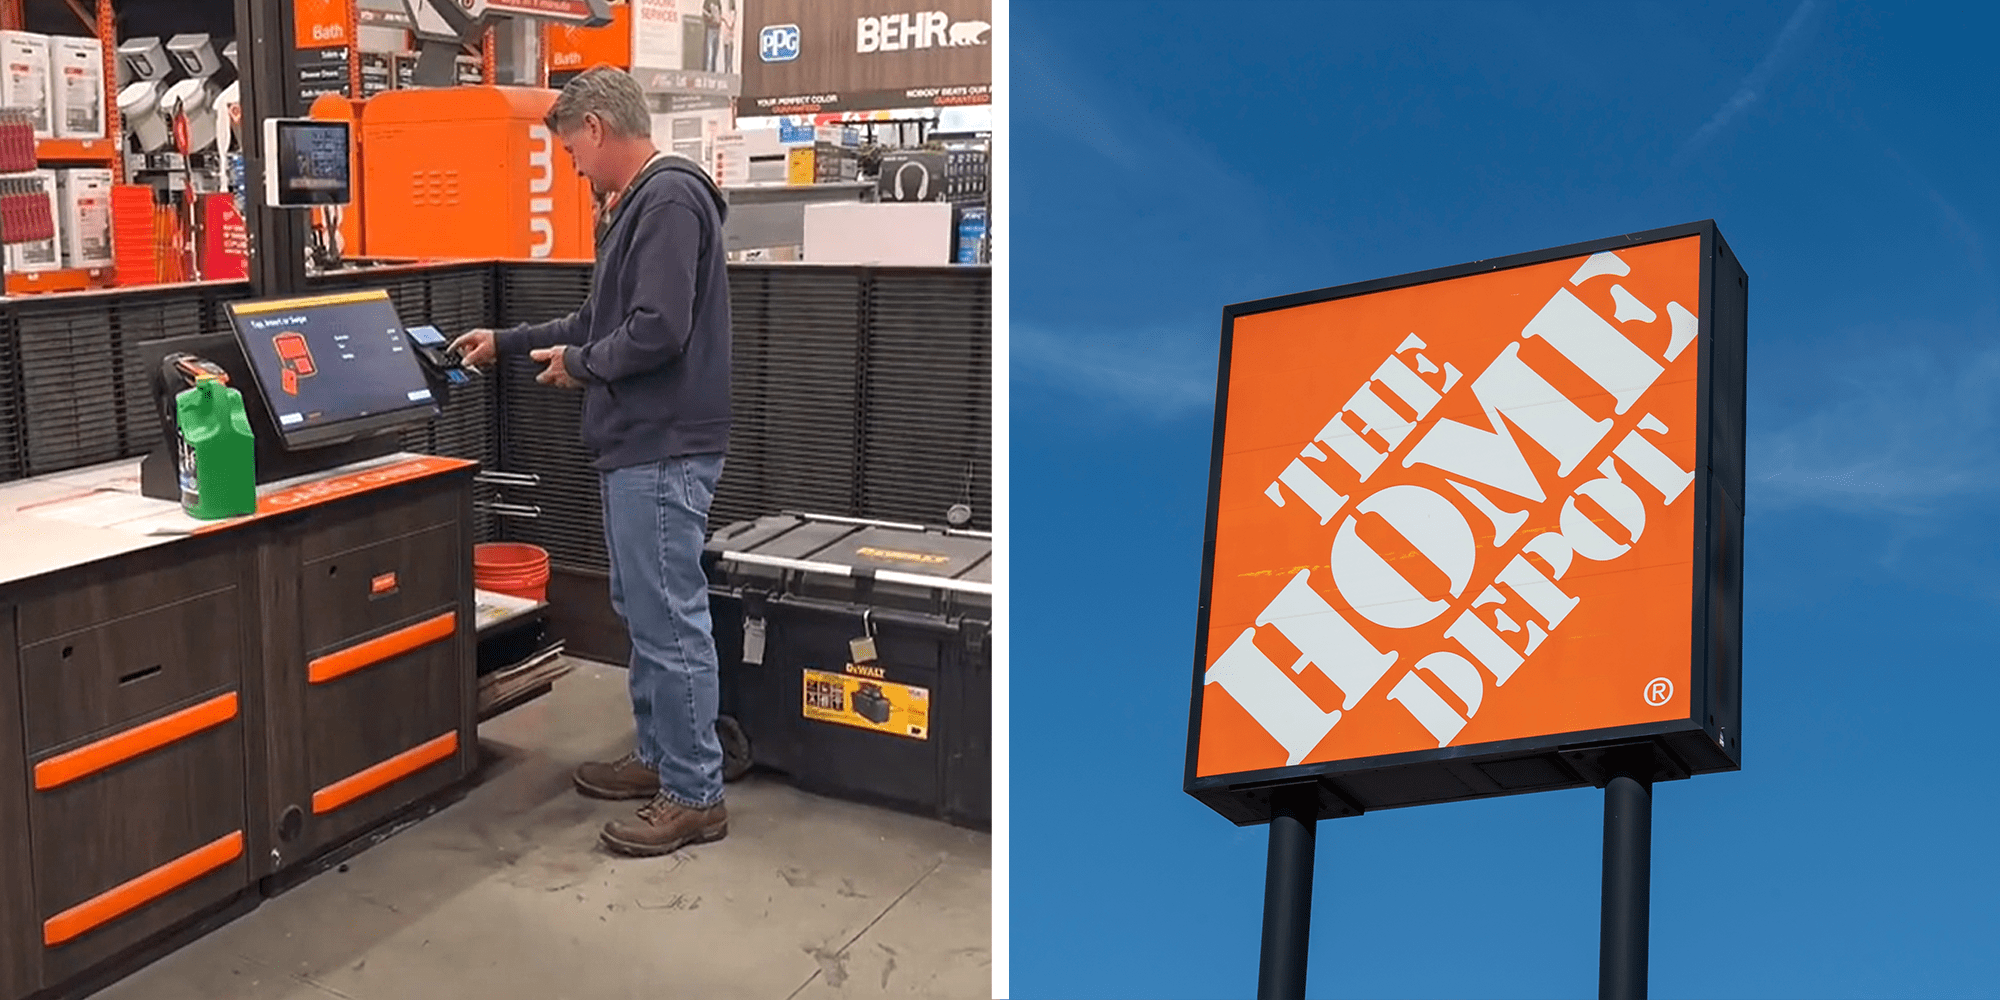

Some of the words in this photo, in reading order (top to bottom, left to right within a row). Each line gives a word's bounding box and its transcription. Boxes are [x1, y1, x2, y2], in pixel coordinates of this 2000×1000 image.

[312, 24, 344, 40] Bath
[762, 29, 798, 56] PPG
[857, 11, 949, 52] BEHR
[554, 52, 582, 65] Bath
[757, 98, 776, 107] YOUR
[778, 96, 810, 105] PERFECT
[811, 93, 838, 103] COLOR
[906, 88, 940, 97] NOBODY
[941, 86, 967, 95] BEATS
[968, 85, 987, 94] OUR
[1265, 332, 1464, 526] THE
[1204, 251, 1699, 767] HOME
[1387, 412, 1695, 748] DEPOT
